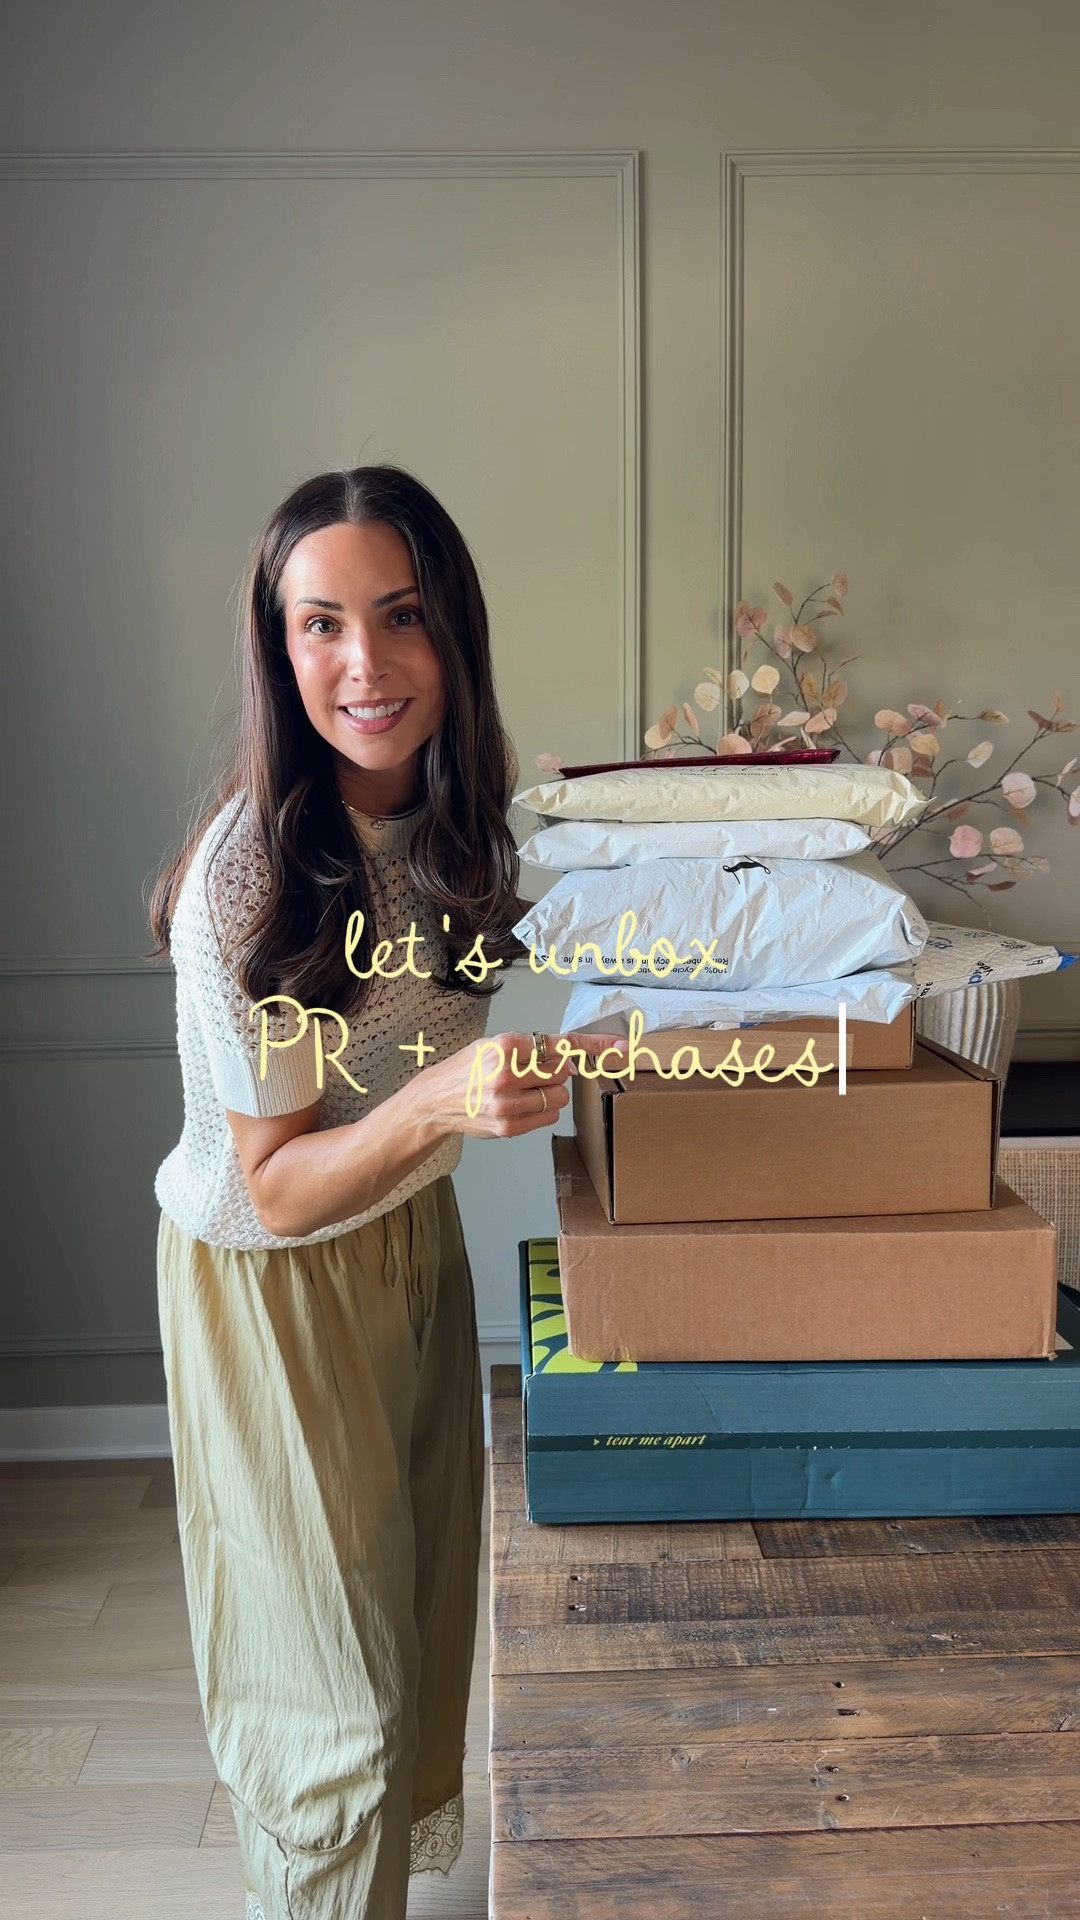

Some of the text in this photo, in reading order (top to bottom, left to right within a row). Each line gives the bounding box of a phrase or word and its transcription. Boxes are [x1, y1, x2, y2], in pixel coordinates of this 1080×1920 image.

[585, 957, 593, 966] in
[626, 958, 634, 966] is
[605, 1434, 707, 1449] tear me apart
